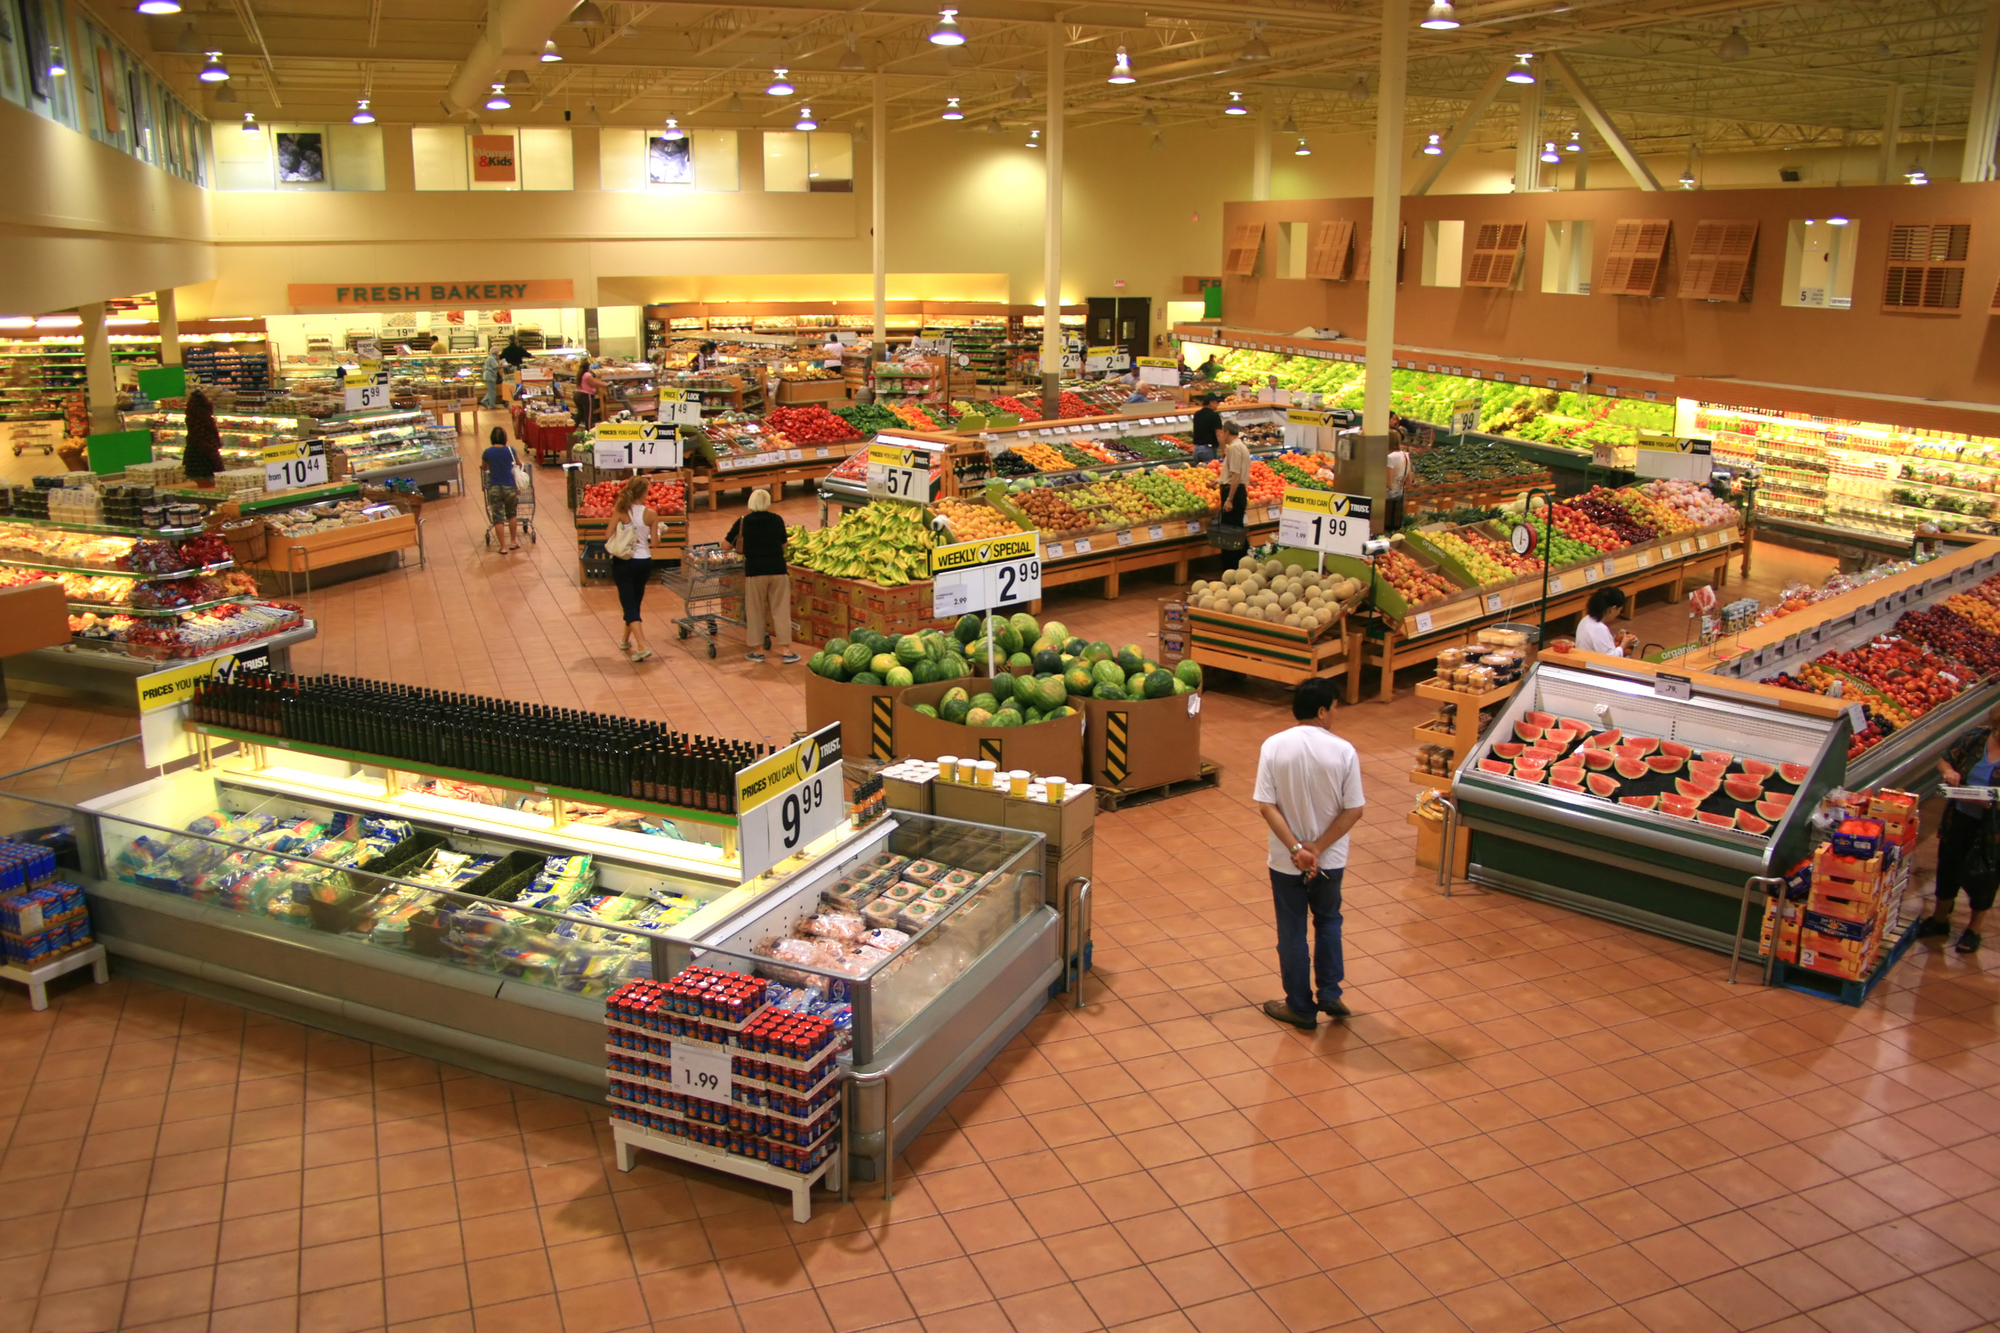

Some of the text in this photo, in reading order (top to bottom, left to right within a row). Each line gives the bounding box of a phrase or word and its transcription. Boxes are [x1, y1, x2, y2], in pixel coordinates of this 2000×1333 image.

[337, 284, 527, 302] FRESH BAKERY
[1800, 291, 1807, 302] 5
[1106, 356, 1113, 369] 2
[362, 387, 380, 406] 5 99
[663, 391, 700, 401] PRICE LOCK
[670, 403, 687, 421] 1 49
[639, 442, 655, 455] 47
[282, 460, 307, 485] 10
[307, 458, 320, 471] 44
[1285, 495, 1305, 504] PRICES
[1305, 498, 1317, 506] YOU
[1317, 499, 1328, 507] CAN
[1312, 516, 1347, 545] 1 99
[938, 541, 1032, 567] WEEKLY SPECIAL
[1422, 540, 1446, 559] organic
[998, 561, 1039, 602] 2 99
[954, 597, 967, 605] 2.99
[1661, 643, 1698, 659] organic
[142, 683, 174, 700] PRICES
[175, 678, 192, 692] YOU
[742, 779, 767, 801] PRICES
[767, 771, 781, 787] YOU
[781, 762, 795, 779] CAN
[782, 779, 823, 849] 9 99
[1802, 952, 1812, 963] 2
[684, 1069, 719, 1090] 1.99
